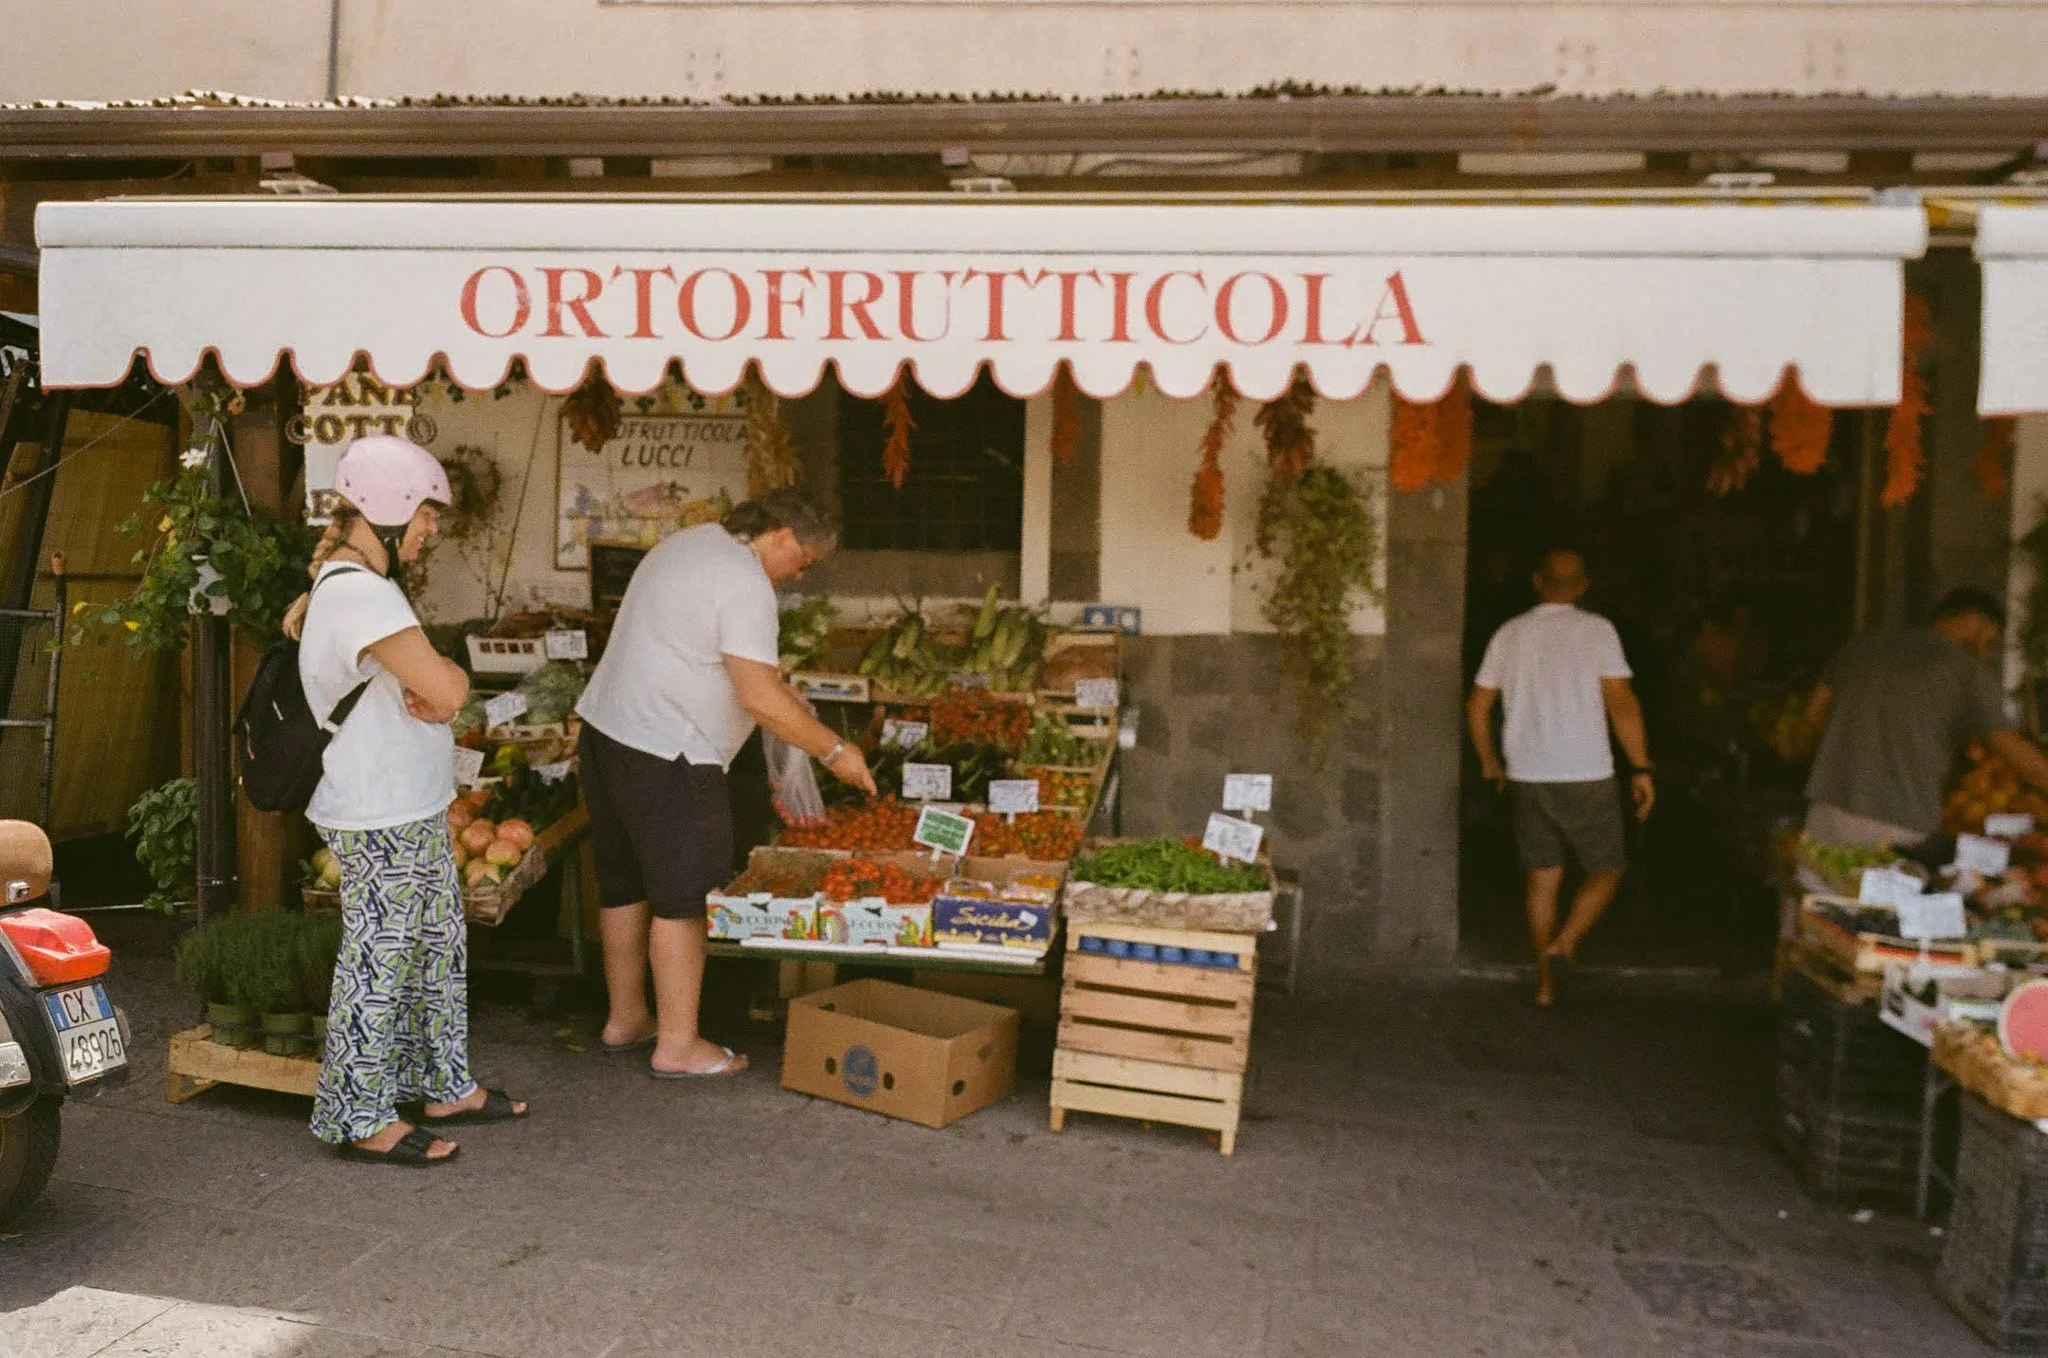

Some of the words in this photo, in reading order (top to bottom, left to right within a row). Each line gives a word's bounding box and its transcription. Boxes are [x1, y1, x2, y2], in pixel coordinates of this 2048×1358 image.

[459, 265, 1433, 347] ORTOFRUTTICOLA
[285, 414, 437, 445] COTTO
[621, 444, 694, 467] LUCCI
[62, 989, 92, 1024] CX
[70, 1028, 121, 1070] 48926
